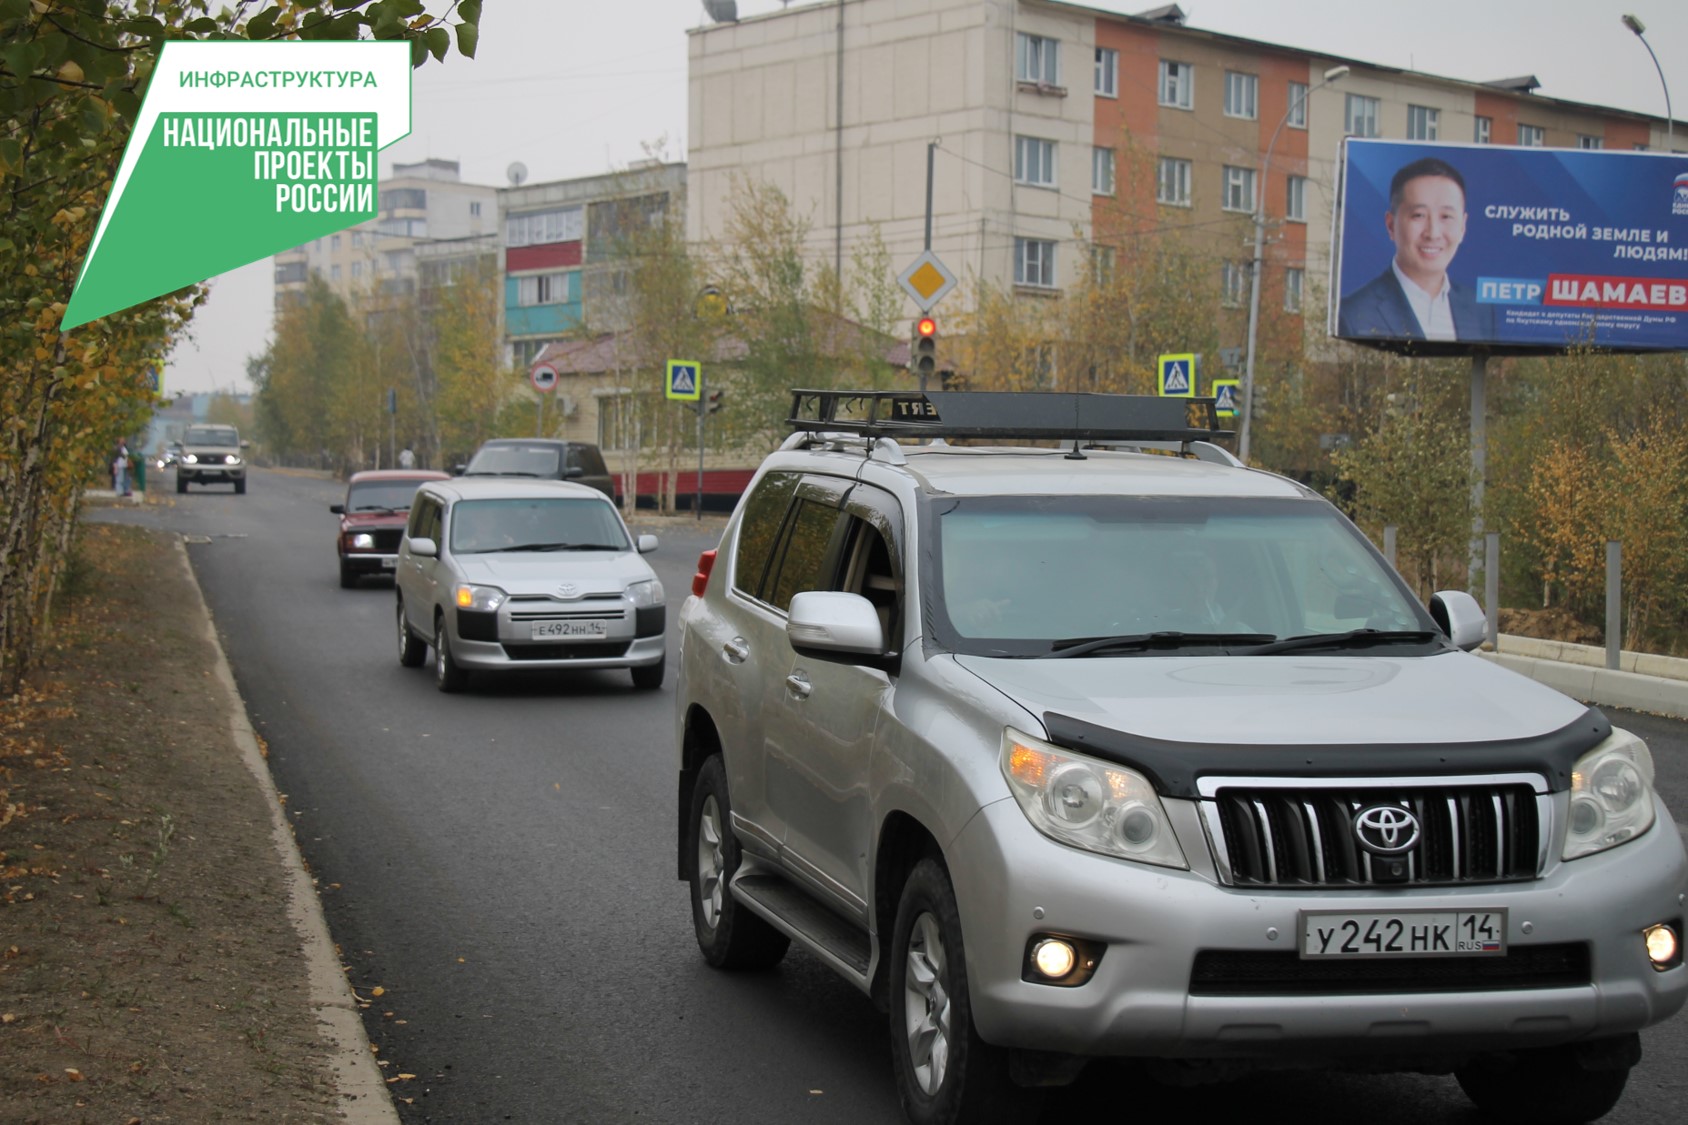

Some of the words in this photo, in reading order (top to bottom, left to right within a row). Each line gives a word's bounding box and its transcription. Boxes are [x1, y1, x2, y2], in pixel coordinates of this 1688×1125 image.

[1484, 204, 1570, 221] СЛУЖИТЬ
[1512, 223, 1587, 240] РОДНОЙ
[1591, 227, 1651, 243] ЗЕМЛЕ
[1656, 230, 1669, 243] И
[1613, 245, 1688, 262] ЛЮДЯМ!
[1482, 282, 1541, 300] ПЕТР
[1551, 280, 1688, 306] ШАМАЕВ
[1463, 914, 1493, 940] 14
[1458, 941, 1482, 950] RUS
